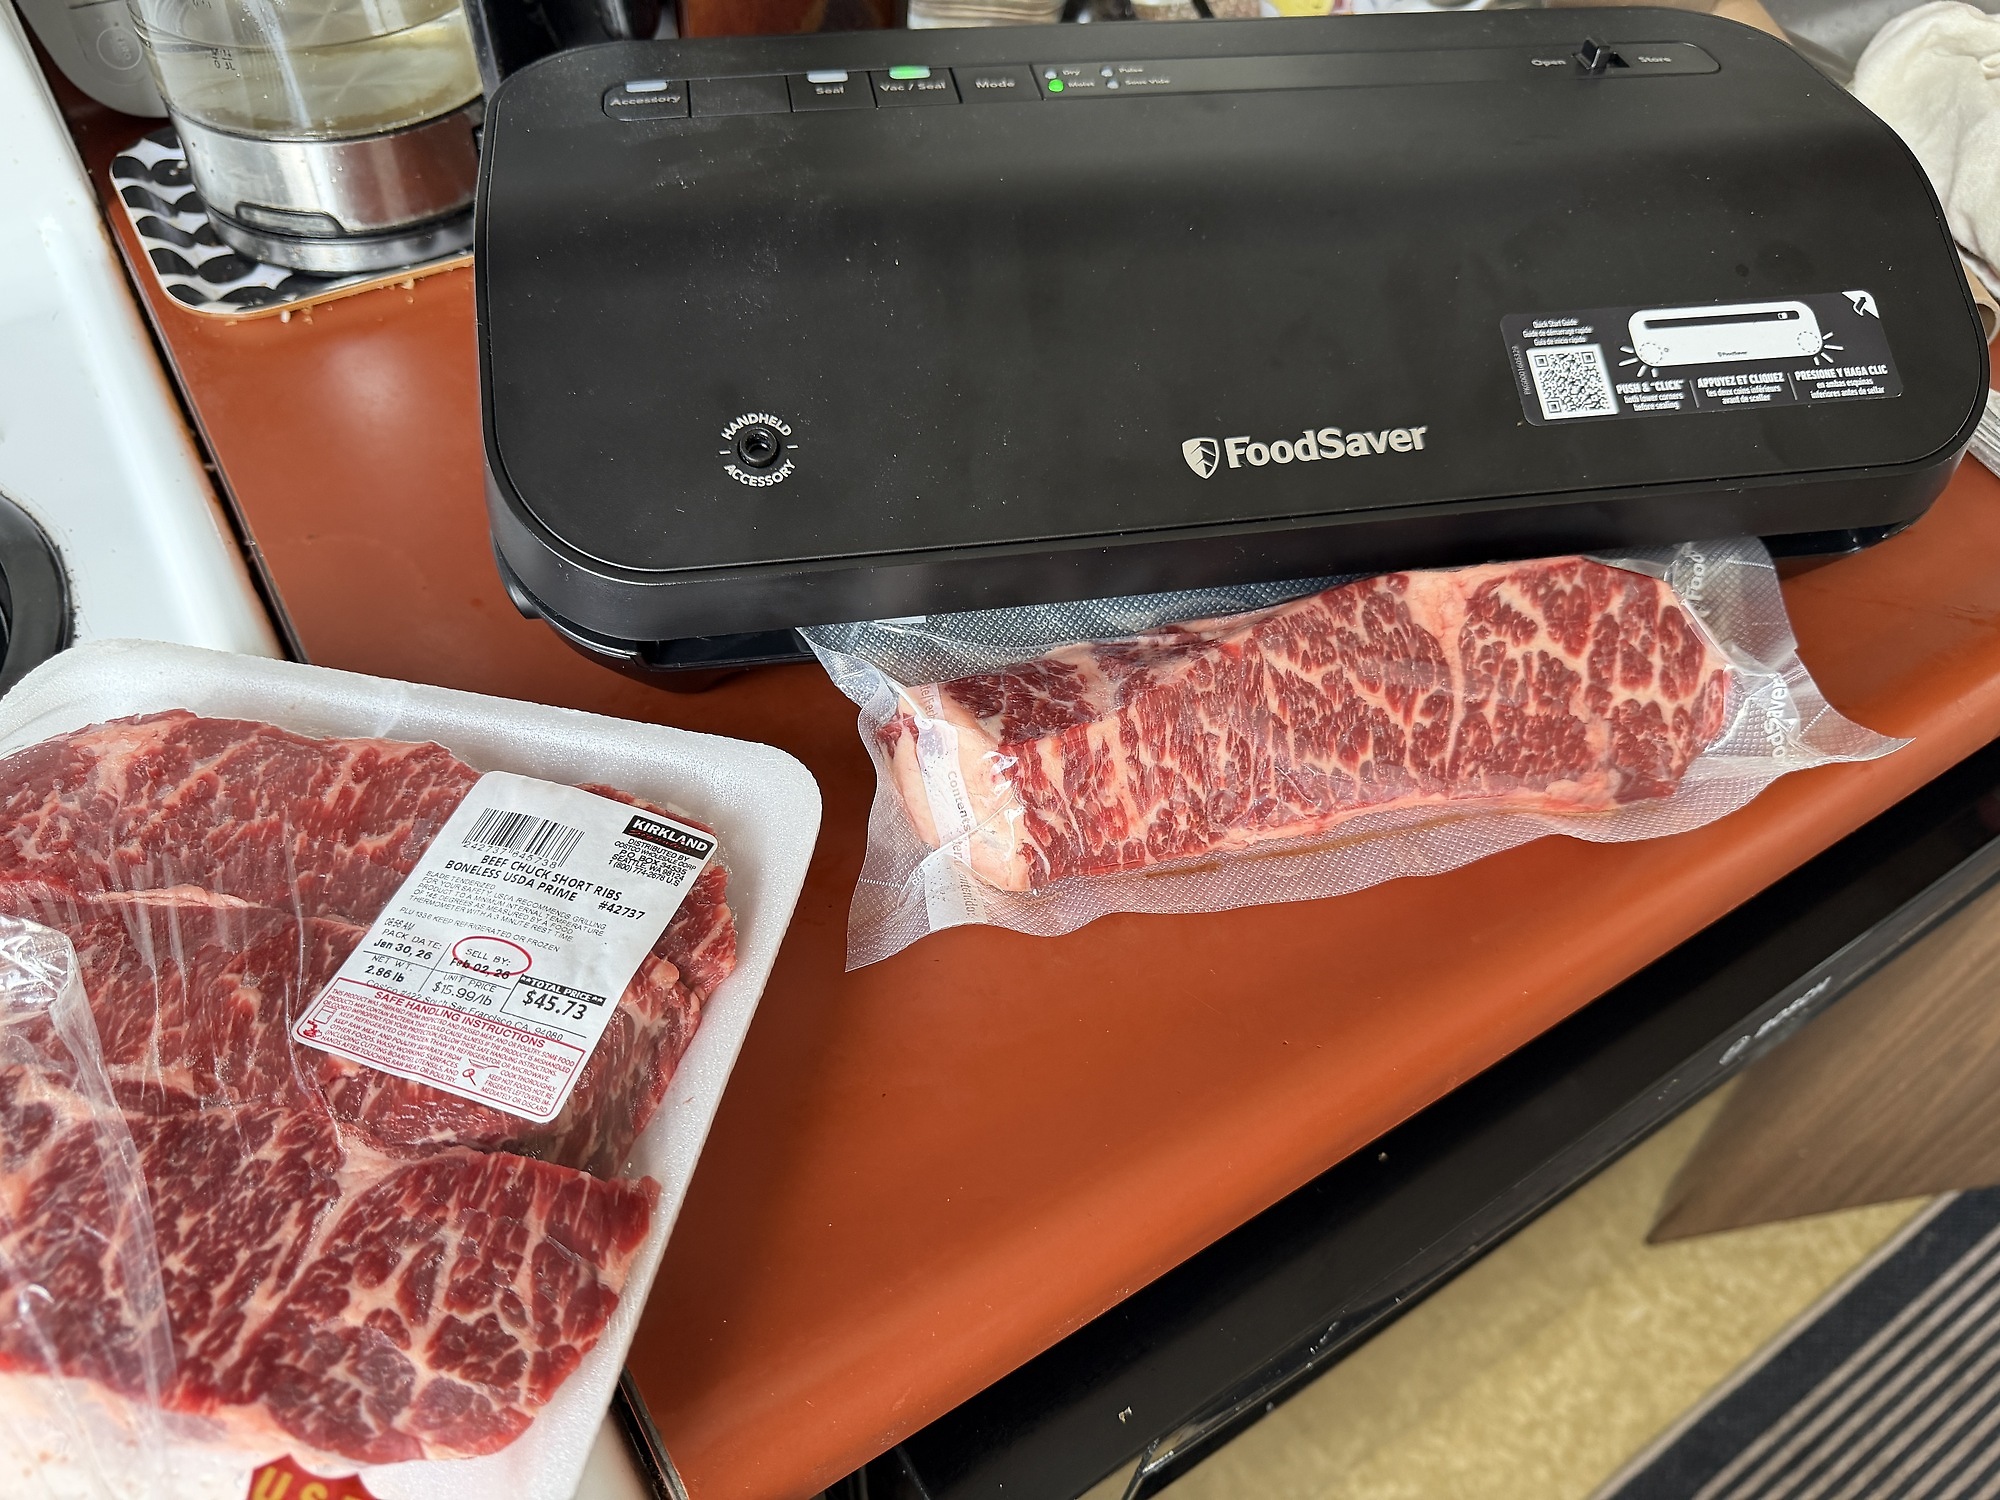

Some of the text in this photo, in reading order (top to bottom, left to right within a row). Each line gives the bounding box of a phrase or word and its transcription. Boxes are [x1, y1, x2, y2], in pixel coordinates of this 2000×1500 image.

[1531, 58, 1566, 67] Open
[816, 85, 844, 95] Seal
[880, 83, 903, 92] Vac
[918, 82, 946, 90] Seal
[975, 79, 1015, 89] Mode
[609, 95, 680, 106] Accessory
[1697, 372, 1785, 388] APPUYEZ ET CLIQUEZ
[1794, 364, 1887, 381] PRESIONE Y HAGA CLIC
[1615, 383, 1639, 395] PUSH
[1640, 383, 1650, 392] &
[1810, 385, 1885, 399] inferiores antes de sellar
[1816, 378, 1874, 389] en ambas esquinas
[1658, 392, 1684, 401] corners
[721, 412, 792, 441] HANDHELD
[1224, 426, 1428, 468] FoodSaver
[723, 458, 796, 487] ACCESSORY
[948, 771, 971, 836] Contents
[632, 819, 707, 850] KIRKLAND
[614, 840, 640, 852] COSTCO
[640, 849, 678, 864] WHOLESALE
[627, 838, 677, 858] DISTRIBUTED
[511, 851, 557, 868] 645738
[638, 854, 660, 865] BOX
[649, 864, 661, 873] WA
[480, 854, 622, 900] BEEF CHUCK SHORT RIBS
[613, 861, 632, 872] (800)
[632, 866, 665, 881] 774-2678
[444, 859, 645, 919] BONELESS USDA PRIME #42737
[450, 875, 495, 889] TENDERIZED
[417, 882, 452, 894] PRODUCT
[473, 895, 505, 906] MINIMUM
[505, 903, 542, 917] INTERNAL
[545, 913, 604, 936] TEMPERATURE
[421, 876, 438, 884] FOR
[440, 880, 461, 890] YOUR
[493, 892, 513, 901] USDA
[515, 897, 571, 919] RECOMMENDS
[572, 915, 606, 929] GRILLING
[409, 894, 466, 912] THERMOMETER
[500, 915, 530, 928] MINUTE
[530, 924, 552, 933] REST
[438, 894, 473, 906] DEGREES
[486, 904, 529, 920] MEASURED
[549, 922, 573, 934] FOOD
[381, 928, 441, 949] PACK DATE:
[399, 906, 415, 914] PLU
[432, 915, 453, 923] KEEP
[453, 920, 511, 938] REFRIGERATED
[512, 934, 526, 942] OR
[526, 937, 560, 952] FROZEN
[373, 938, 432, 959] Jan 30, 26
[465, 948, 510, 966] SELL BY:
[364, 964, 404, 982] 2.86 lb
[371, 955, 412, 971] NET WT.
[449, 957, 511, 979] Feb 02, 26
[431, 981, 492, 1005] $15.99/lb
[443, 974, 496, 992] UNIT PRICE
[364, 979, 397, 994] Costco
[467, 1007, 512, 1026] Francisco
[532, 1027, 563, 1041] 94080
[522, 989, 587, 1019] $45.73
[374, 991, 545, 1047] SAFE HANDLING INSTRUCTIONS
